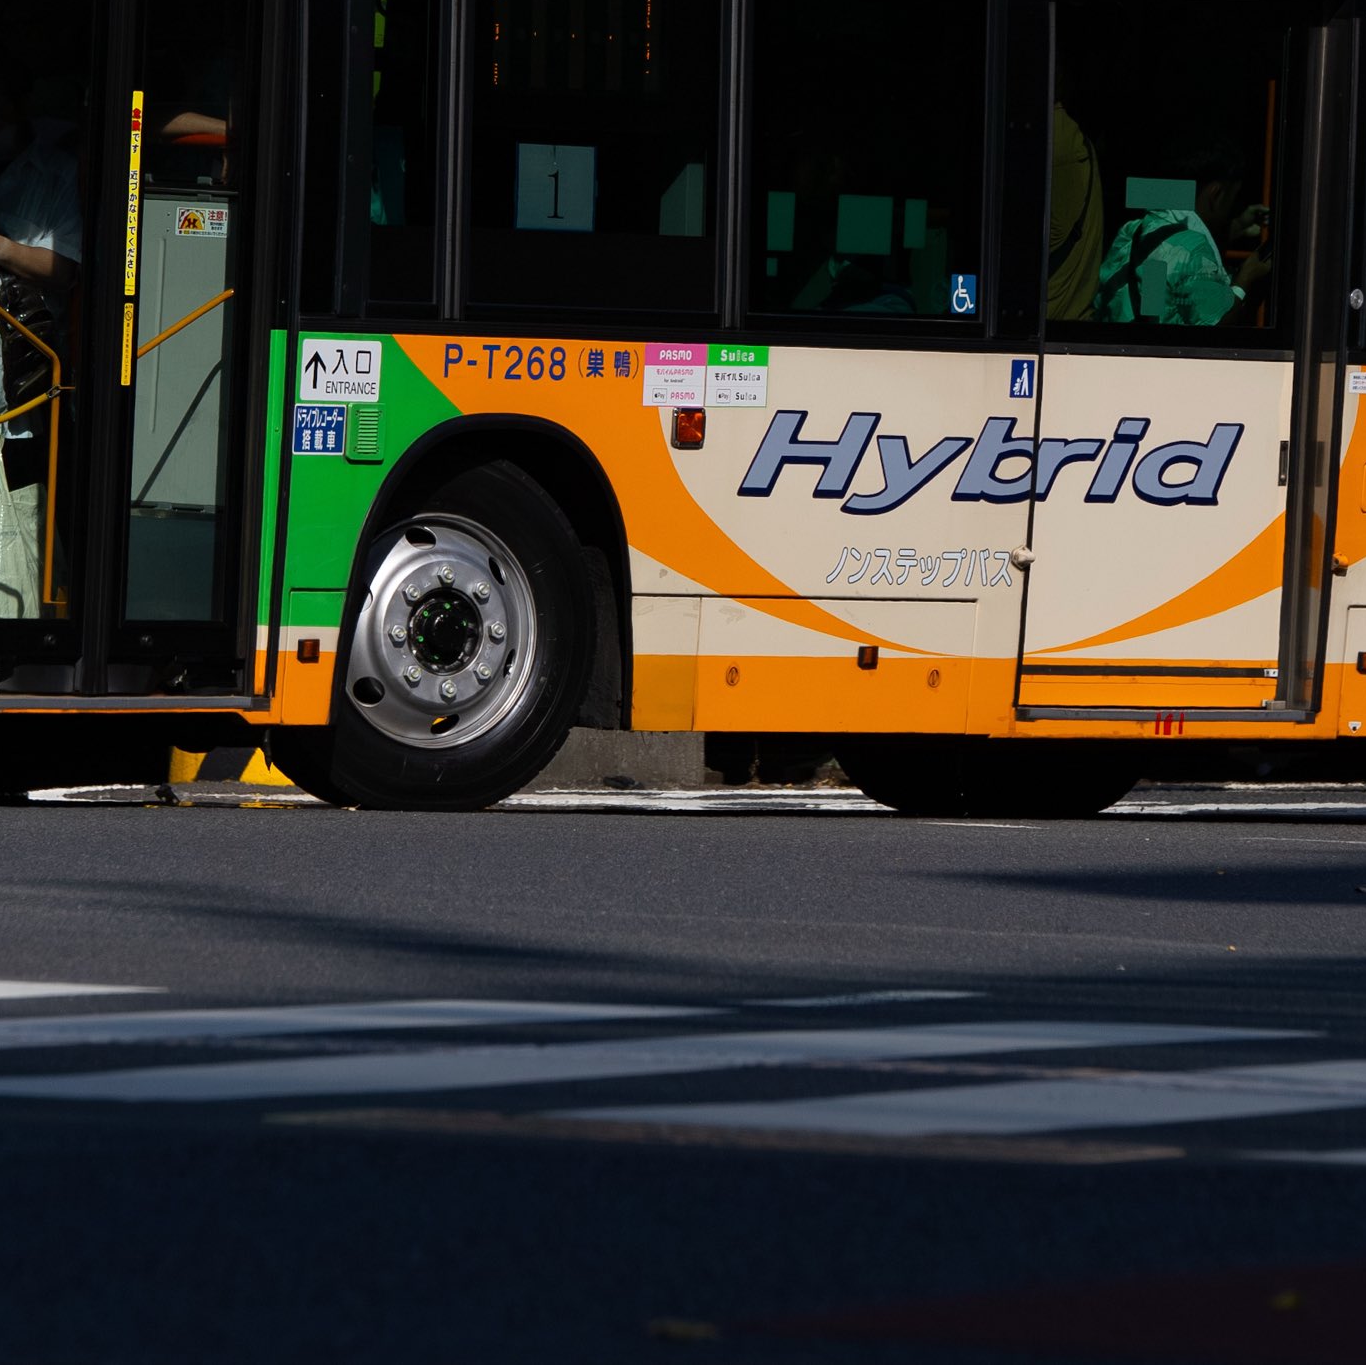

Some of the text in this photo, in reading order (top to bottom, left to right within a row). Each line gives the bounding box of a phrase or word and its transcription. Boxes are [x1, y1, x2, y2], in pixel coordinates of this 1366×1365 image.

[332, 349, 372, 375] 入口
[659, 349, 693, 361] PASMO
[720, 349, 755, 362] Suica
[325, 381, 377, 395] ENTRANCE
[670, 392, 695, 400] PASMO
[735, 392, 757, 401] Suica
[296, 408, 344, 428] ドライブレコーダー
[302, 429, 336, 451] 搭載車
[737, 409, 1245, 516] Hybrid
[826, 546, 1013, 588] ノンステップバス
